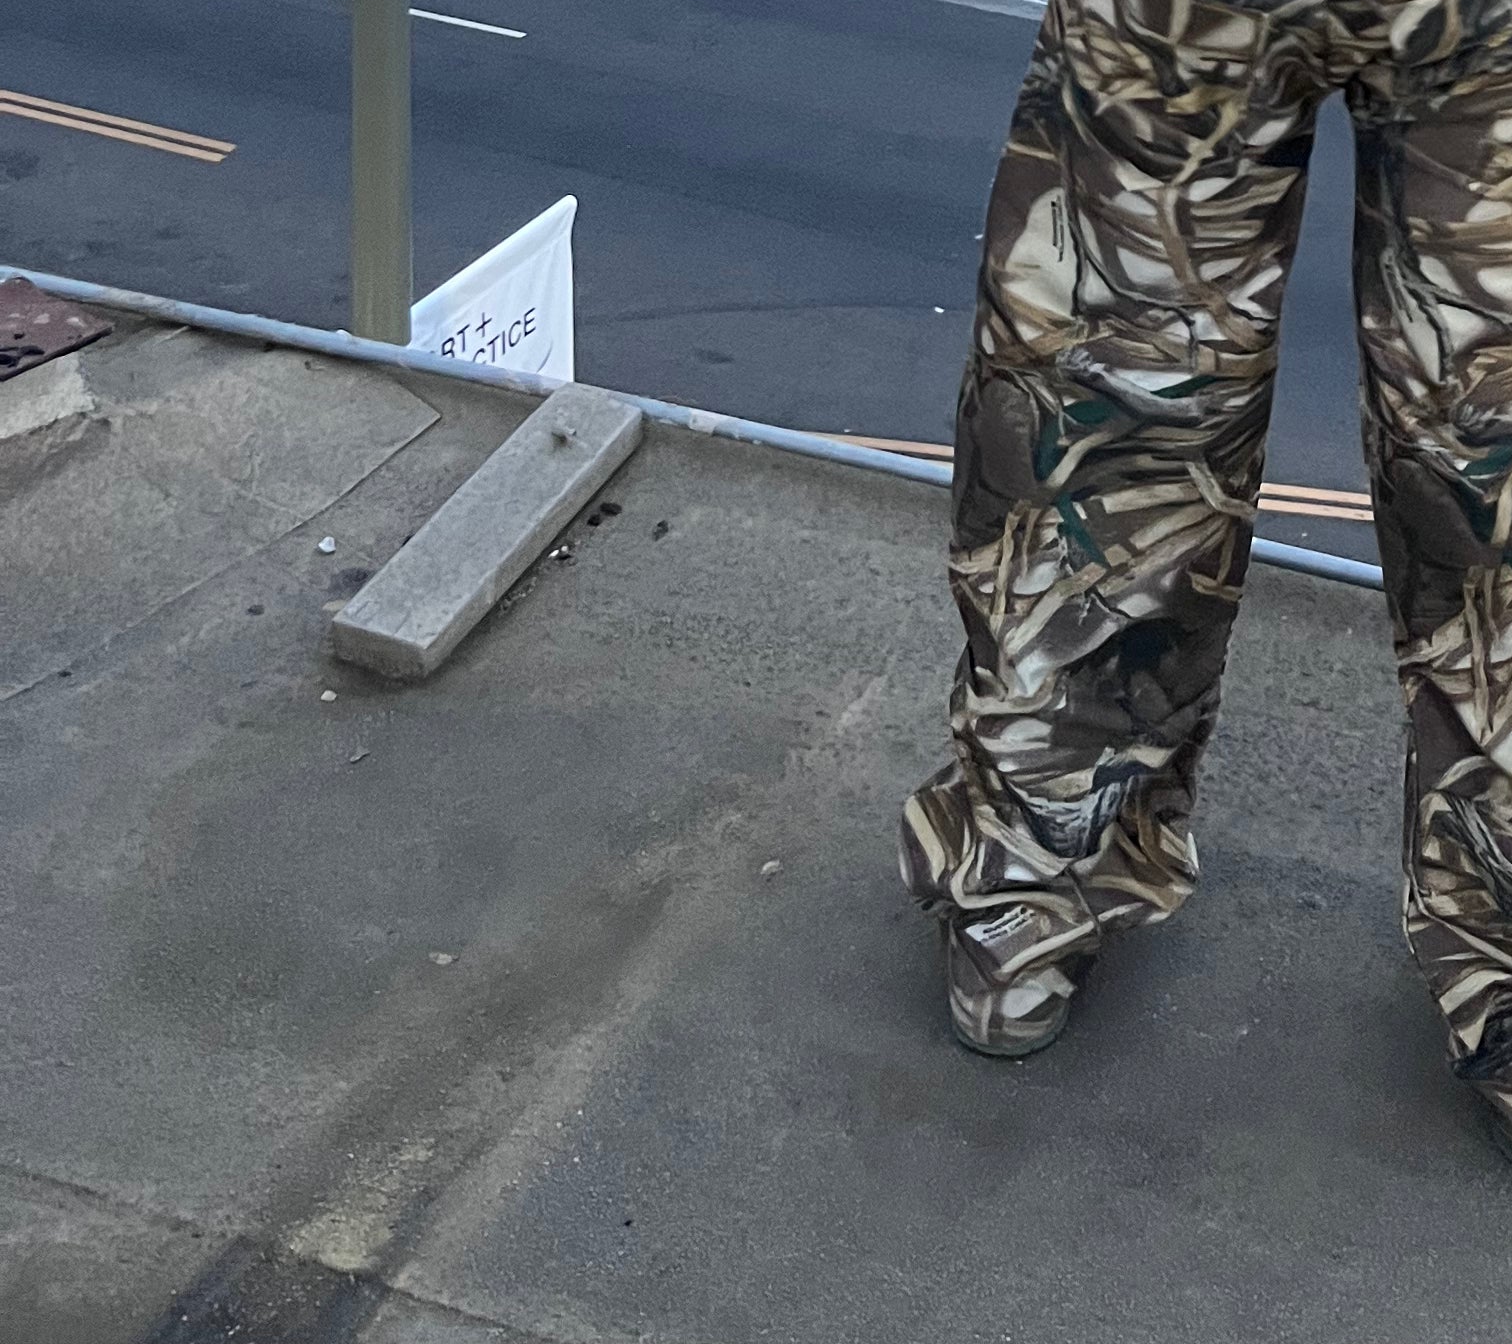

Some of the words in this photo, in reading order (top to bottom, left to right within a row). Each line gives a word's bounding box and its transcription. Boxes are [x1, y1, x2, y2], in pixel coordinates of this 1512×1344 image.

[430, 323, 470, 358] RT
[475, 311, 493, 338] +
[472, 306, 537, 364] CTICE
